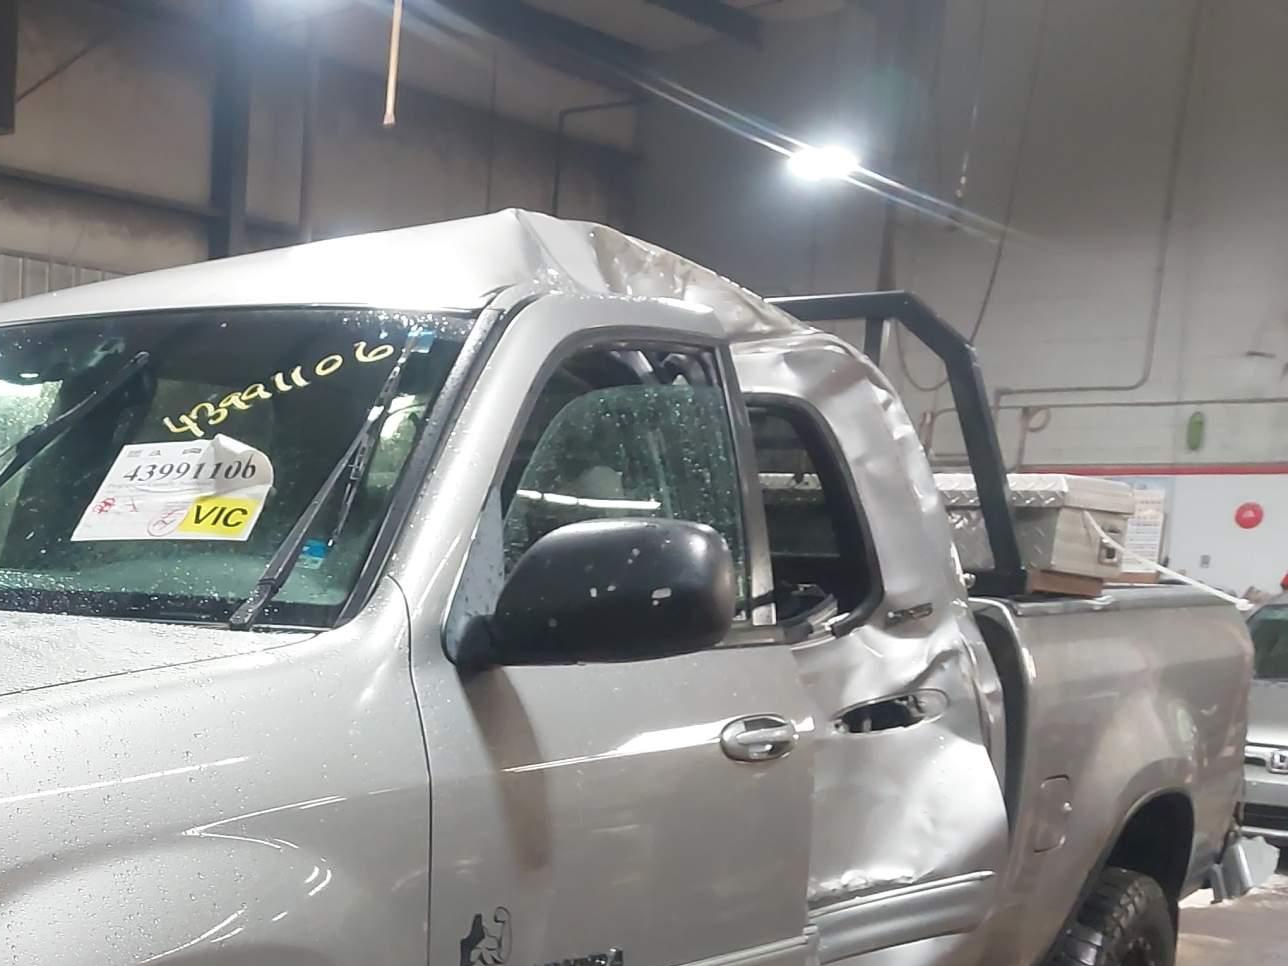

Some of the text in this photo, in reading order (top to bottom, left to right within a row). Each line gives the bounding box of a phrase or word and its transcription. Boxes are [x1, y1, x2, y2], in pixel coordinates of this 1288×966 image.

[162, 341, 395, 438] 43991106
[123, 454, 256, 482] 43991106
[193, 504, 249, 528] VIC
